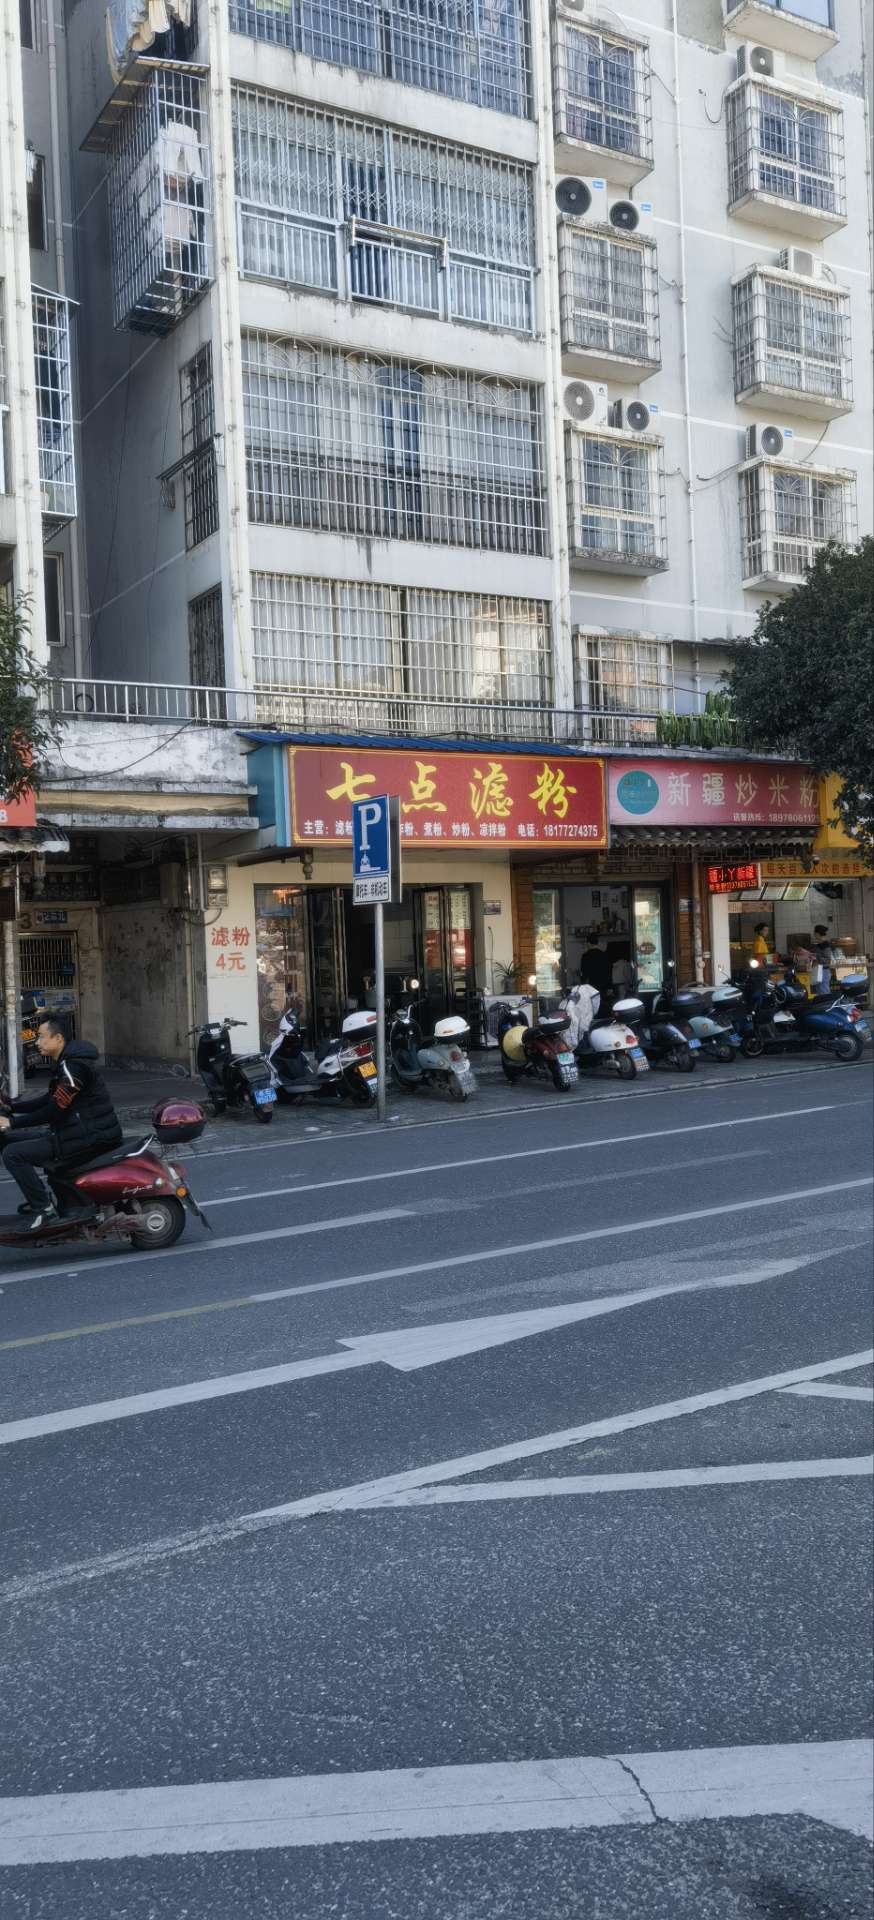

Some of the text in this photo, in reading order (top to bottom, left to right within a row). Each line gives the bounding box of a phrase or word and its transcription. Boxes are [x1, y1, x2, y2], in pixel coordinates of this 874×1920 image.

[325, 760, 577, 819] 七点滤粉
[666, 772, 819, 808] 新疆炒米粉
[358, 802, 382, 851] P
[211, 926, 250, 947] 滤粉
[216, 951, 246, 971] 4元
